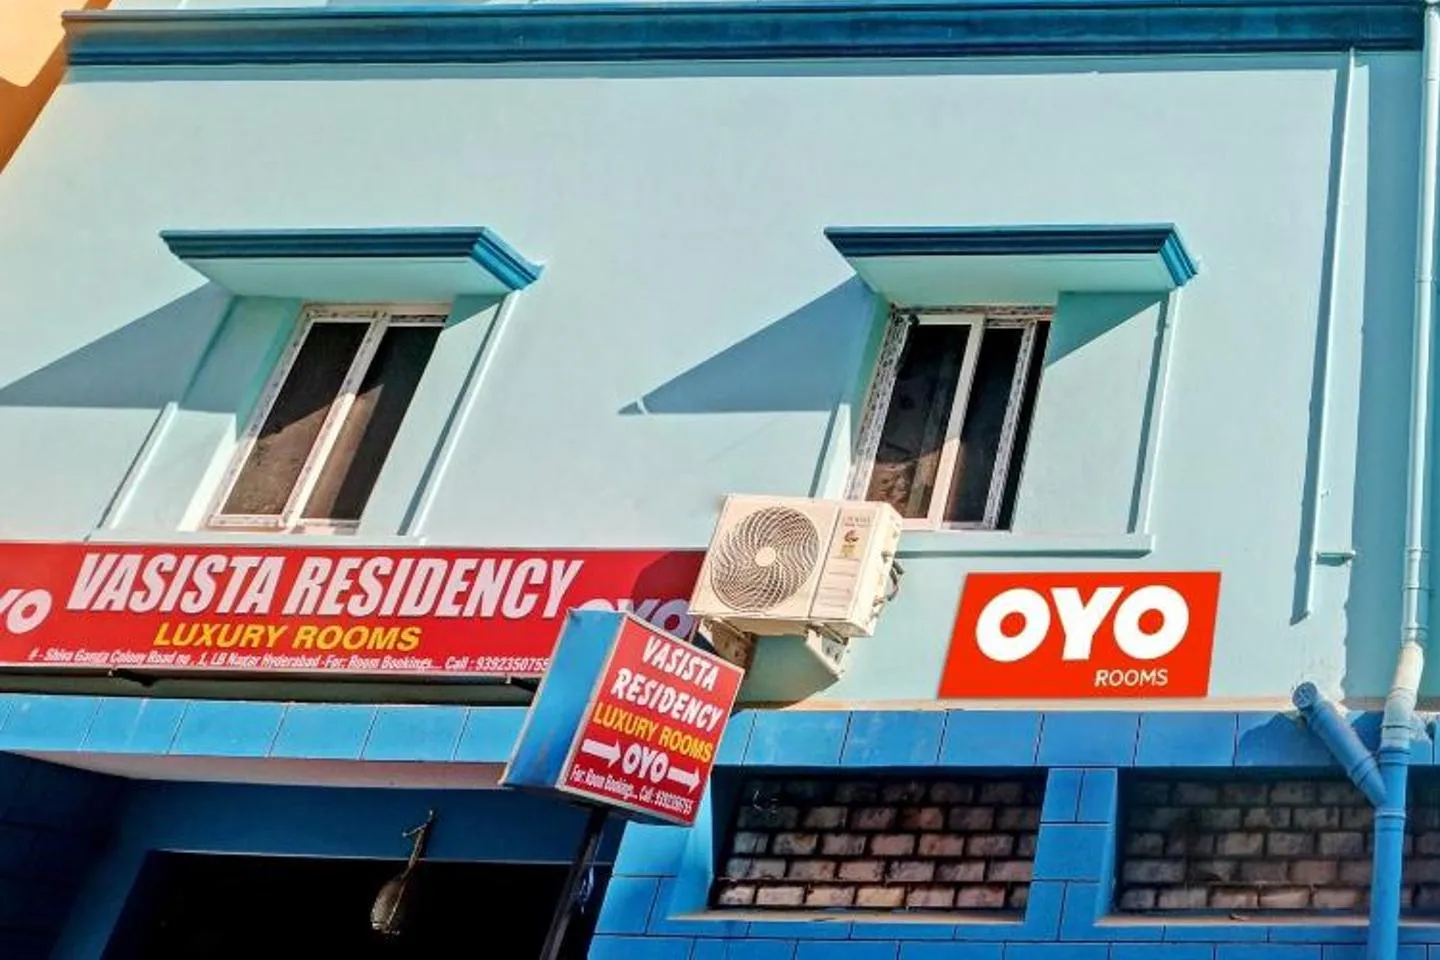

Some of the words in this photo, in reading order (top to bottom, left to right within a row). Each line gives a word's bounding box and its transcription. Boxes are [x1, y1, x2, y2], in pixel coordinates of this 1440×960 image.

[65, 553, 286, 614] VASISTA
[281, 555, 584, 618] RESIDENCY
[153, 622, 287, 649] LUXURY
[292, 624, 421, 652] ROOMS
[975, 585, 1190, 662] OYO
[109, 649, 146, 665] Colony
[210, 652, 229, 666] LB
[228, 652, 262, 668] Nagar
[348, 655, 380, 670] Room
[642, 636, 720, 692] VASISTA
[1094, 668, 1168, 687] ROOMS
[611, 667, 723, 732] RESIDENCY
[593, 702, 658, 742] LUXURY
[658, 725, 713, 763] ROOMS
[622, 743, 669, 783] OYO
